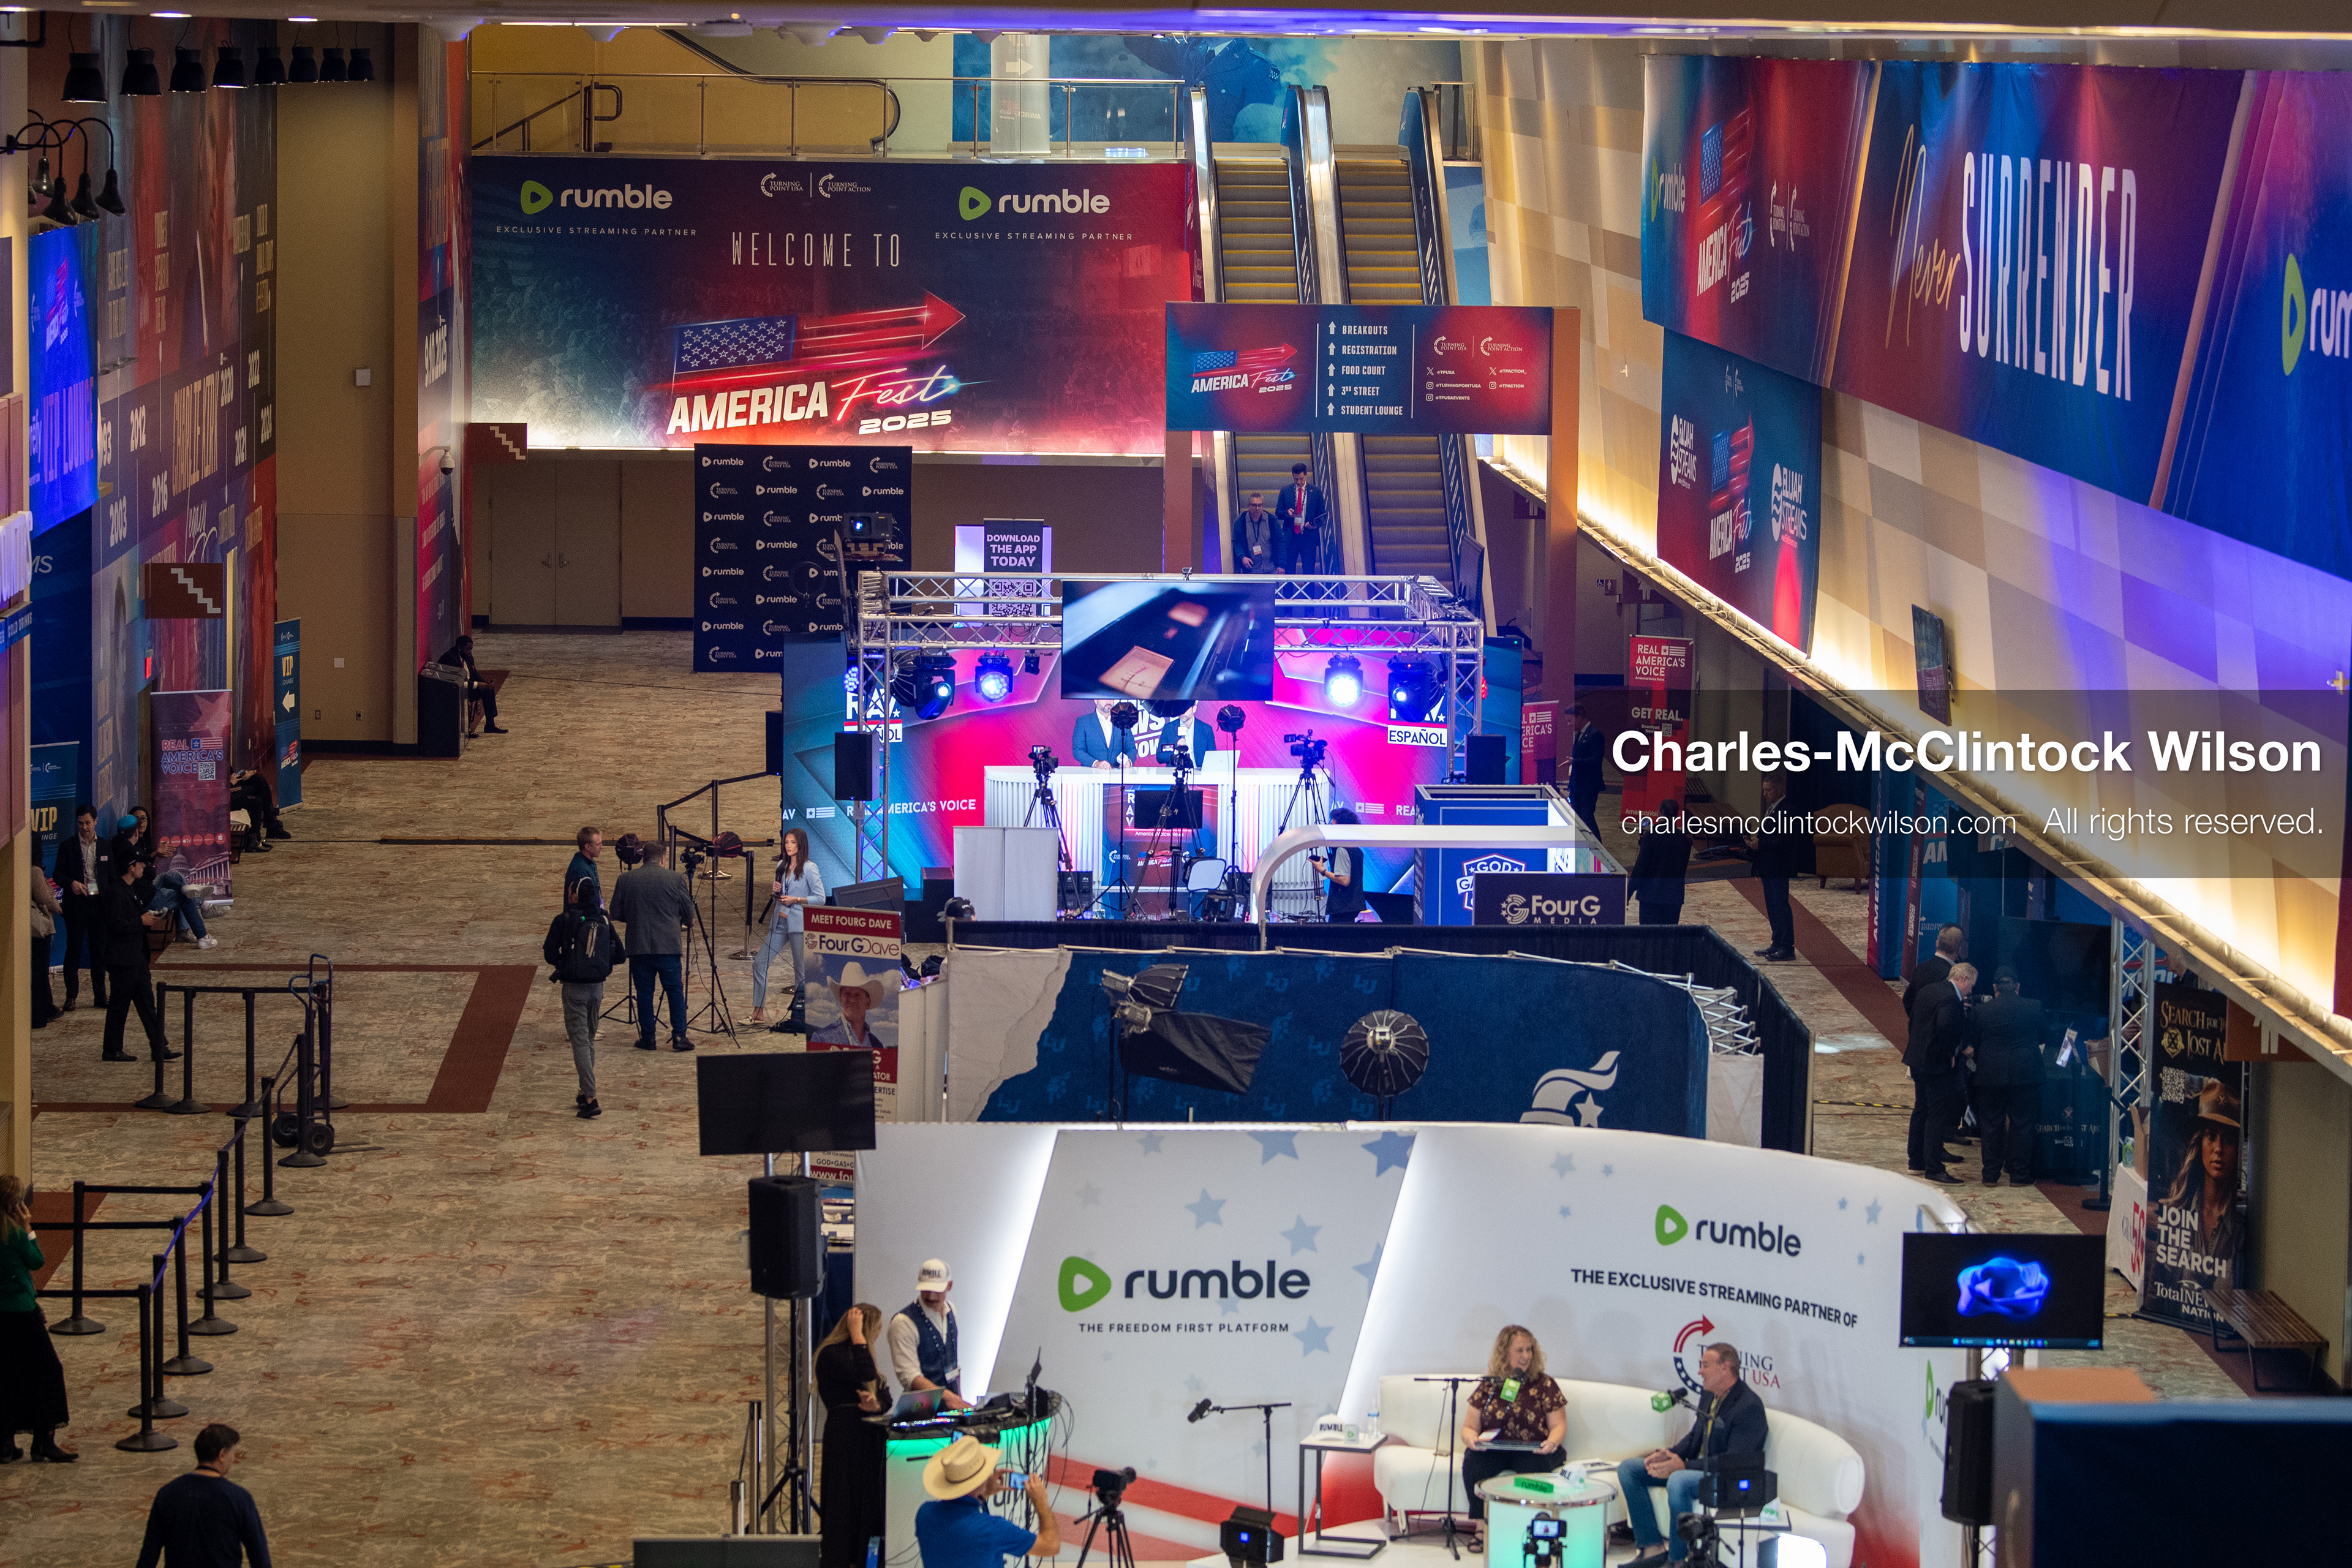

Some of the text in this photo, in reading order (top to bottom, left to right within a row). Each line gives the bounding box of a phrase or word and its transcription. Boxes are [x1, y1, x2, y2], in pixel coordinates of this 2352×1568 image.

[560, 184, 673, 209] rumble
[998, 189, 1110, 214] rumble
[732, 232, 899, 267] WELCOME TO
[1960, 151, 2137, 402] SURRENDER
[1342, 325, 1388, 335] BREAKOUTS
[424, 324, 447, 388] 9.10.2025
[1341, 345, 1397, 355] REGISTRATION
[1191, 368, 1296, 393] AMERICA Fest
[1341, 366, 1385, 375] FOOD COURT
[221, 365, 234, 407] 2020
[1259, 384, 1292, 393] 2025
[1354, 386, 1380, 396] STREET
[666, 365, 957, 435] AMERICA Fest
[1341, 405, 1403, 415] STUDENT LOUNGE
[43, 393, 60, 484] VIP
[63, 376, 94, 476] LOUNGE
[130, 405, 146, 453] 2012
[858, 409, 952, 435] 2025
[152, 470, 168, 518] 2016
[1782, 467, 1803, 505] ELIJAH
[110, 496, 127, 548] 2003
[1781, 500, 1807, 540] STREAMS
[987, 534, 1041, 543] DOWNLOAD
[990, 545, 1037, 554] THE APP
[990, 556, 1036, 567] TODAY
[1637, 644, 1659, 655] REAL
[282, 655, 293, 677] VIP
[1635, 655, 1686, 668] AMERICA'S
[1635, 666, 1665, 677] VOICE
[1631, 707, 1683, 722] GET REAL.
[1389, 727, 1446, 745] ESPAÑOL
[1521, 724, 1552, 736] ERICA'S
[162, 739, 189, 751] REAL
[1135, 737, 1159, 758] OW
[161, 750, 224, 763] AMERICA'S
[162, 762, 198, 775] VOICE
[940, 799, 976, 811] VOICE
[1396, 805, 1415, 816] REA
[1476, 861, 1512, 872] GOD
[811, 913, 892, 930] MEET FOURG DAVE
[2160, 1000, 2205, 1029] SEARCH
[874, 1086, 895, 1096] ERTISE
[2157, 1205, 2199, 1231] JOIN
[1695, 1219, 1801, 1257] rumble
[2157, 1224, 2191, 1250] THE
[2155, 1244, 2226, 1278] SEARCH
[1125, 1260, 1311, 1299] rumble
[1570, 1268, 1858, 1329] THE EXCLUSIVE STREAMING PARTNER OF
[2154, 1281, 2209, 1308] TotalNE
[1078, 1323, 1289, 1333] THE FREEDOM FIRST PLATFORM
[1753, 1370, 1781, 1389] USA
